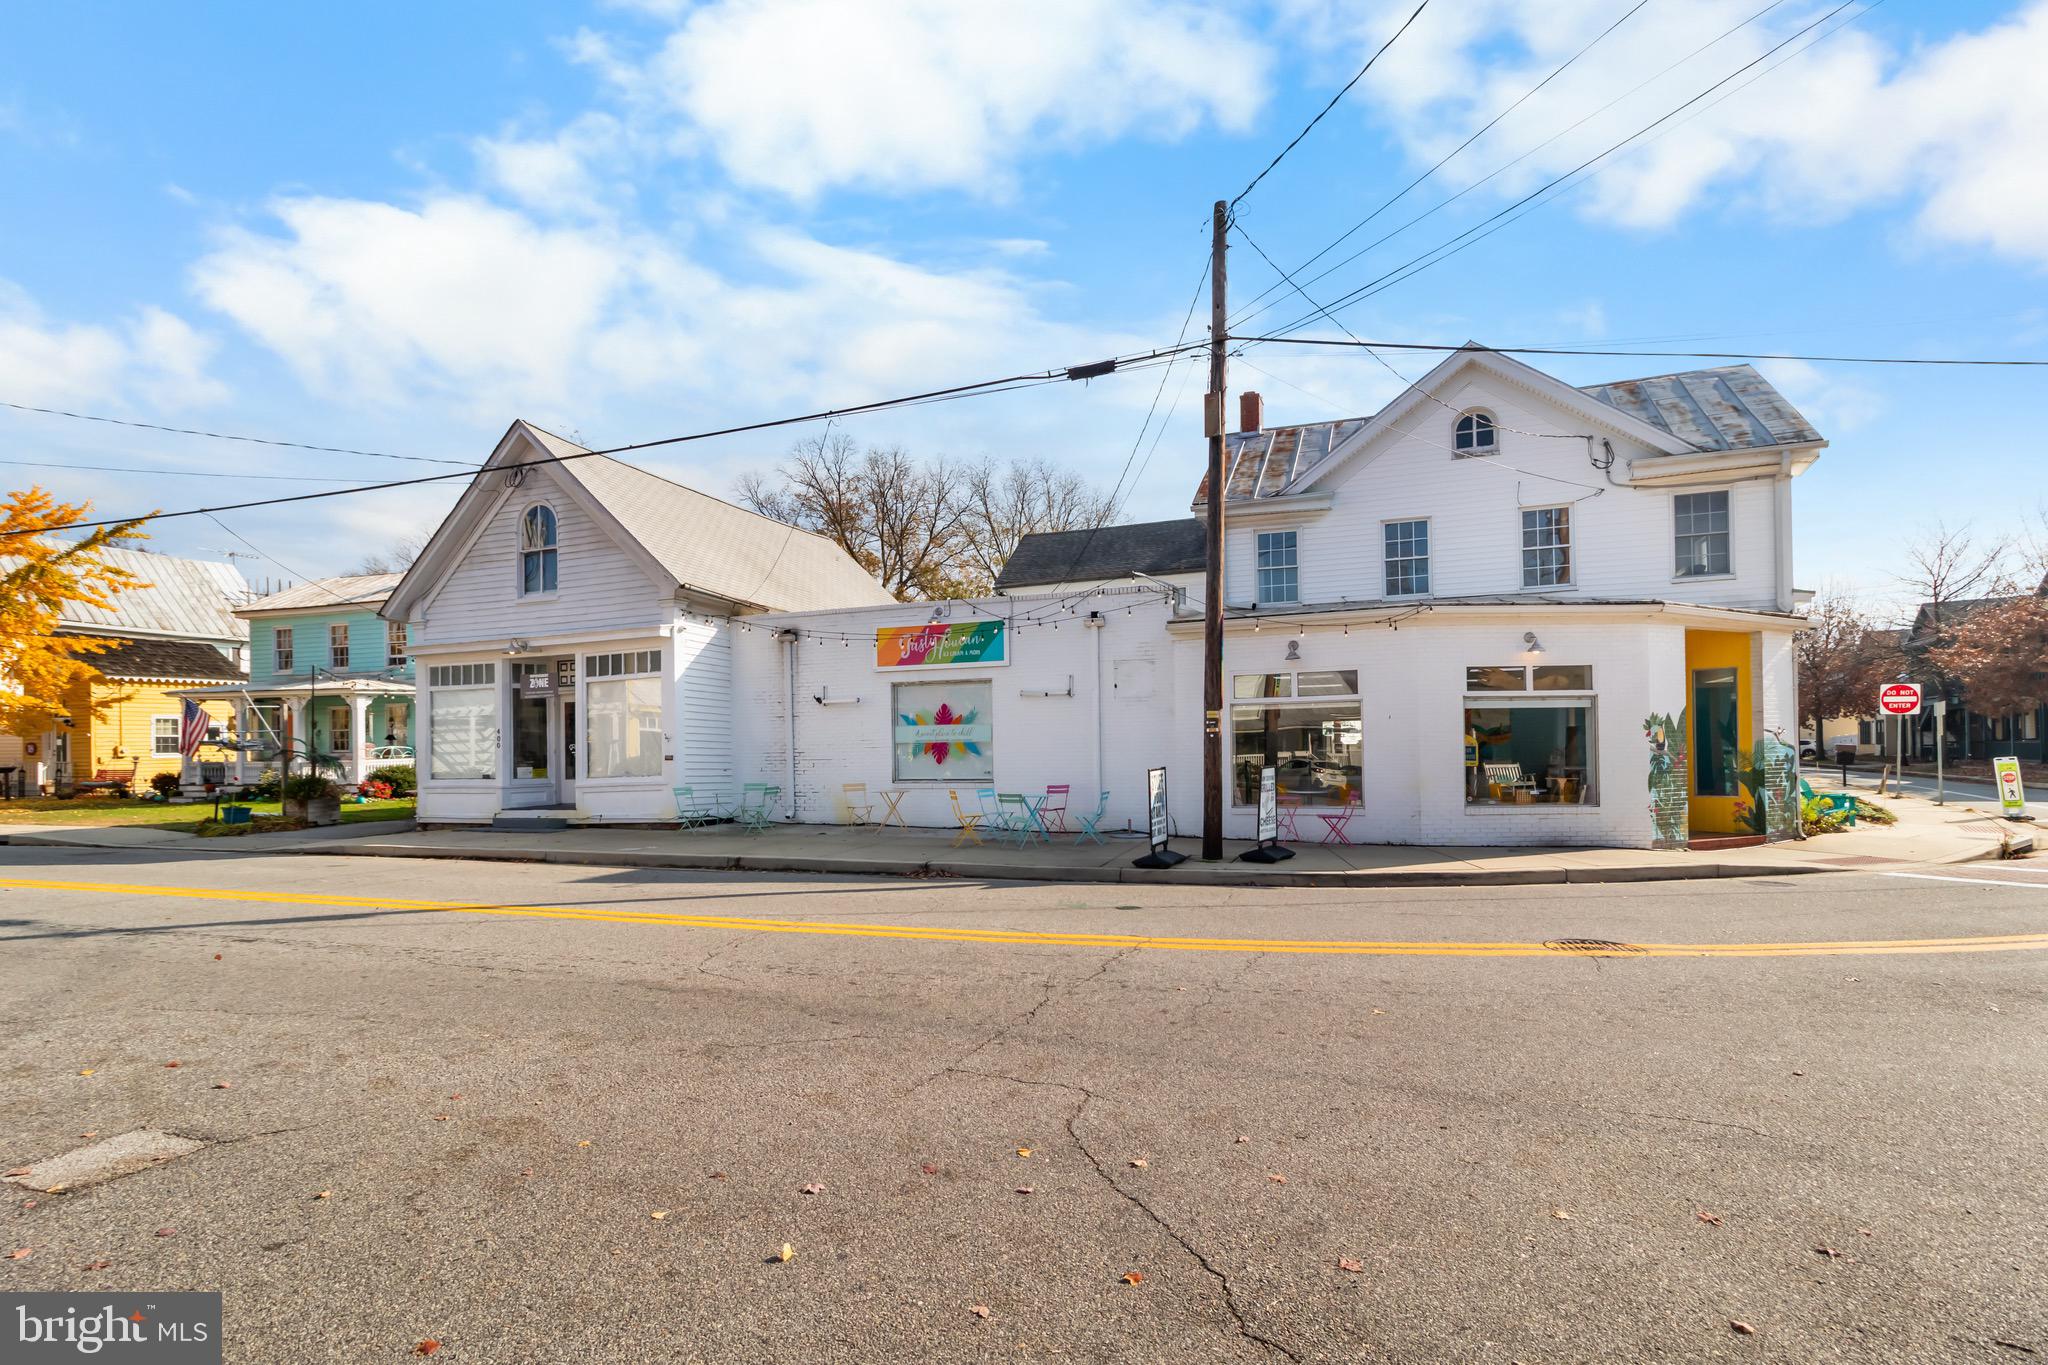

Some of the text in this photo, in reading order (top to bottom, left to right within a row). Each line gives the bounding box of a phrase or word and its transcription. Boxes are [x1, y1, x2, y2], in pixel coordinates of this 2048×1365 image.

[899, 628, 980, 660] Tasty Toucan
[529, 678, 549, 688] ZONE
